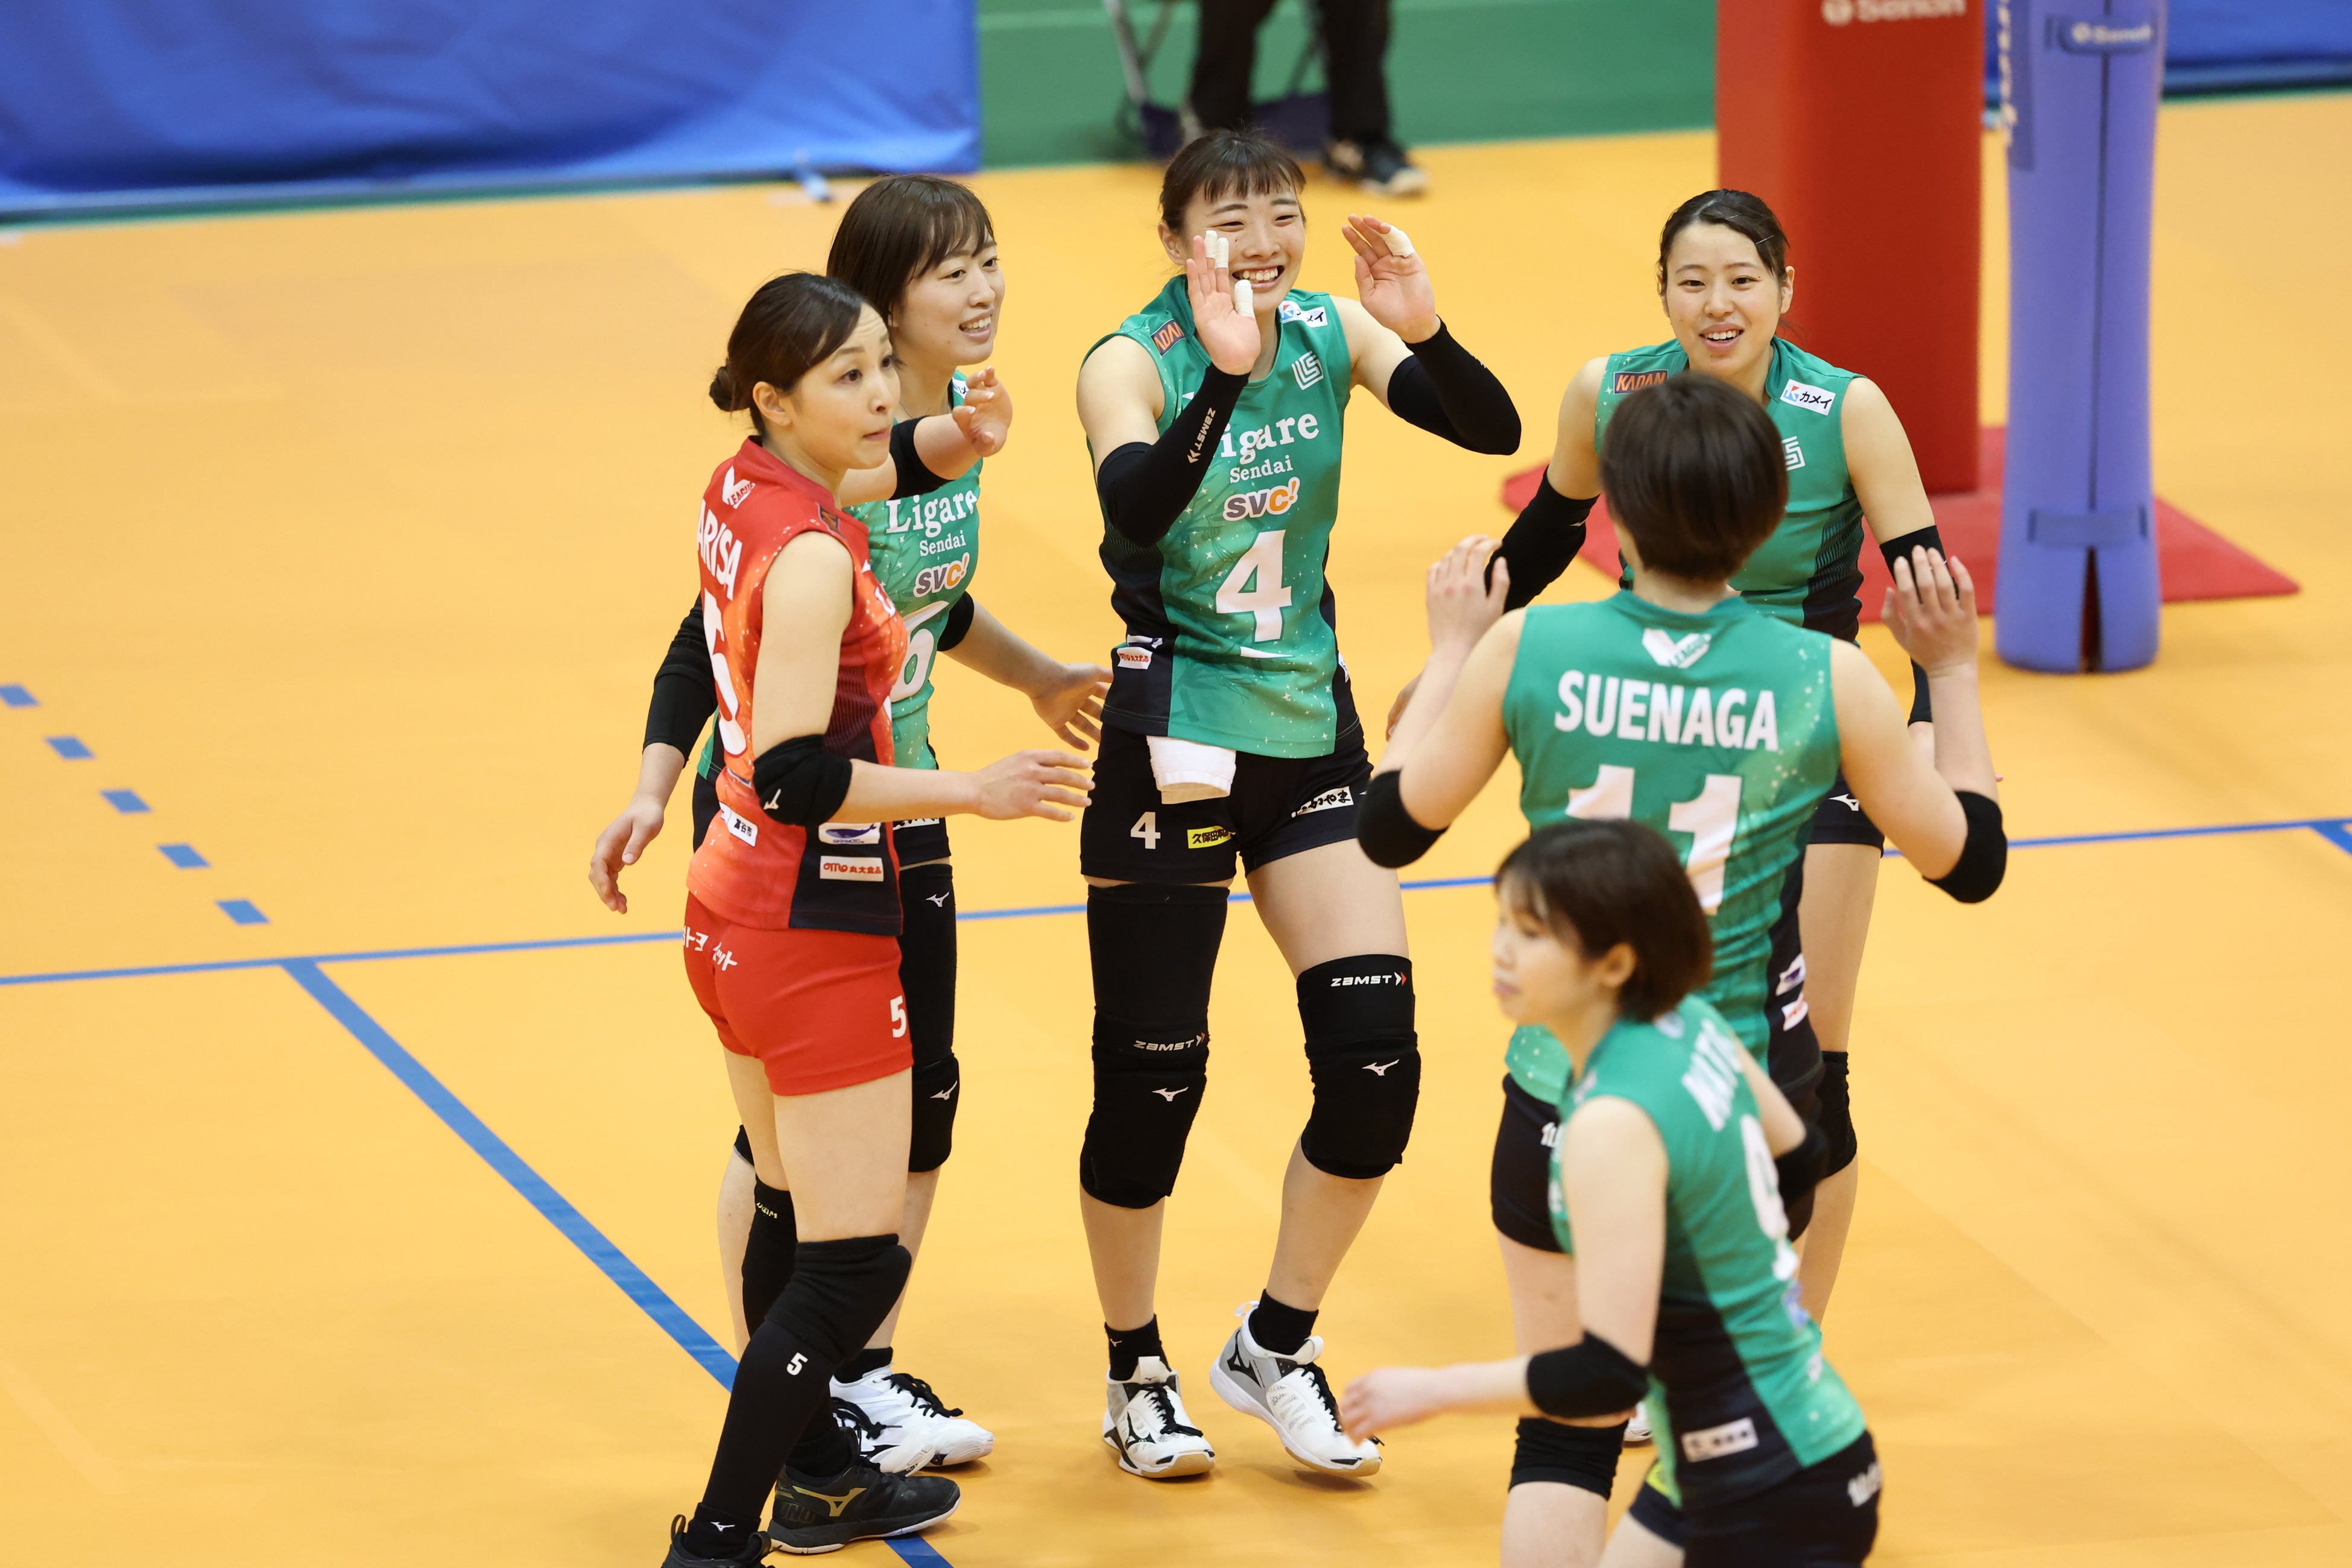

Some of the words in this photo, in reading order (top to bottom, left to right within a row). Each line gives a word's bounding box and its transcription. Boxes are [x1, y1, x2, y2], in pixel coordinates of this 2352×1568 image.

[1616, 372, 1667, 391] KADAN
[1799, 391, 1832, 409] カメイ
[1219, 413, 1320, 465] igare
[1229, 454, 1294, 484] Sendai
[885, 490, 978, 537] Ligare
[697, 498, 743, 601] ARISA
[919, 529, 967, 557] Sendai
[1215, 528, 1292, 643] 4
[889, 601, 950, 703] 6
[1554, 669, 1779, 752] SUENAGA
[1130, 811, 1162, 850] 4
[890, 995, 908, 1038] 5
[786, 1351, 809, 1376] 5
